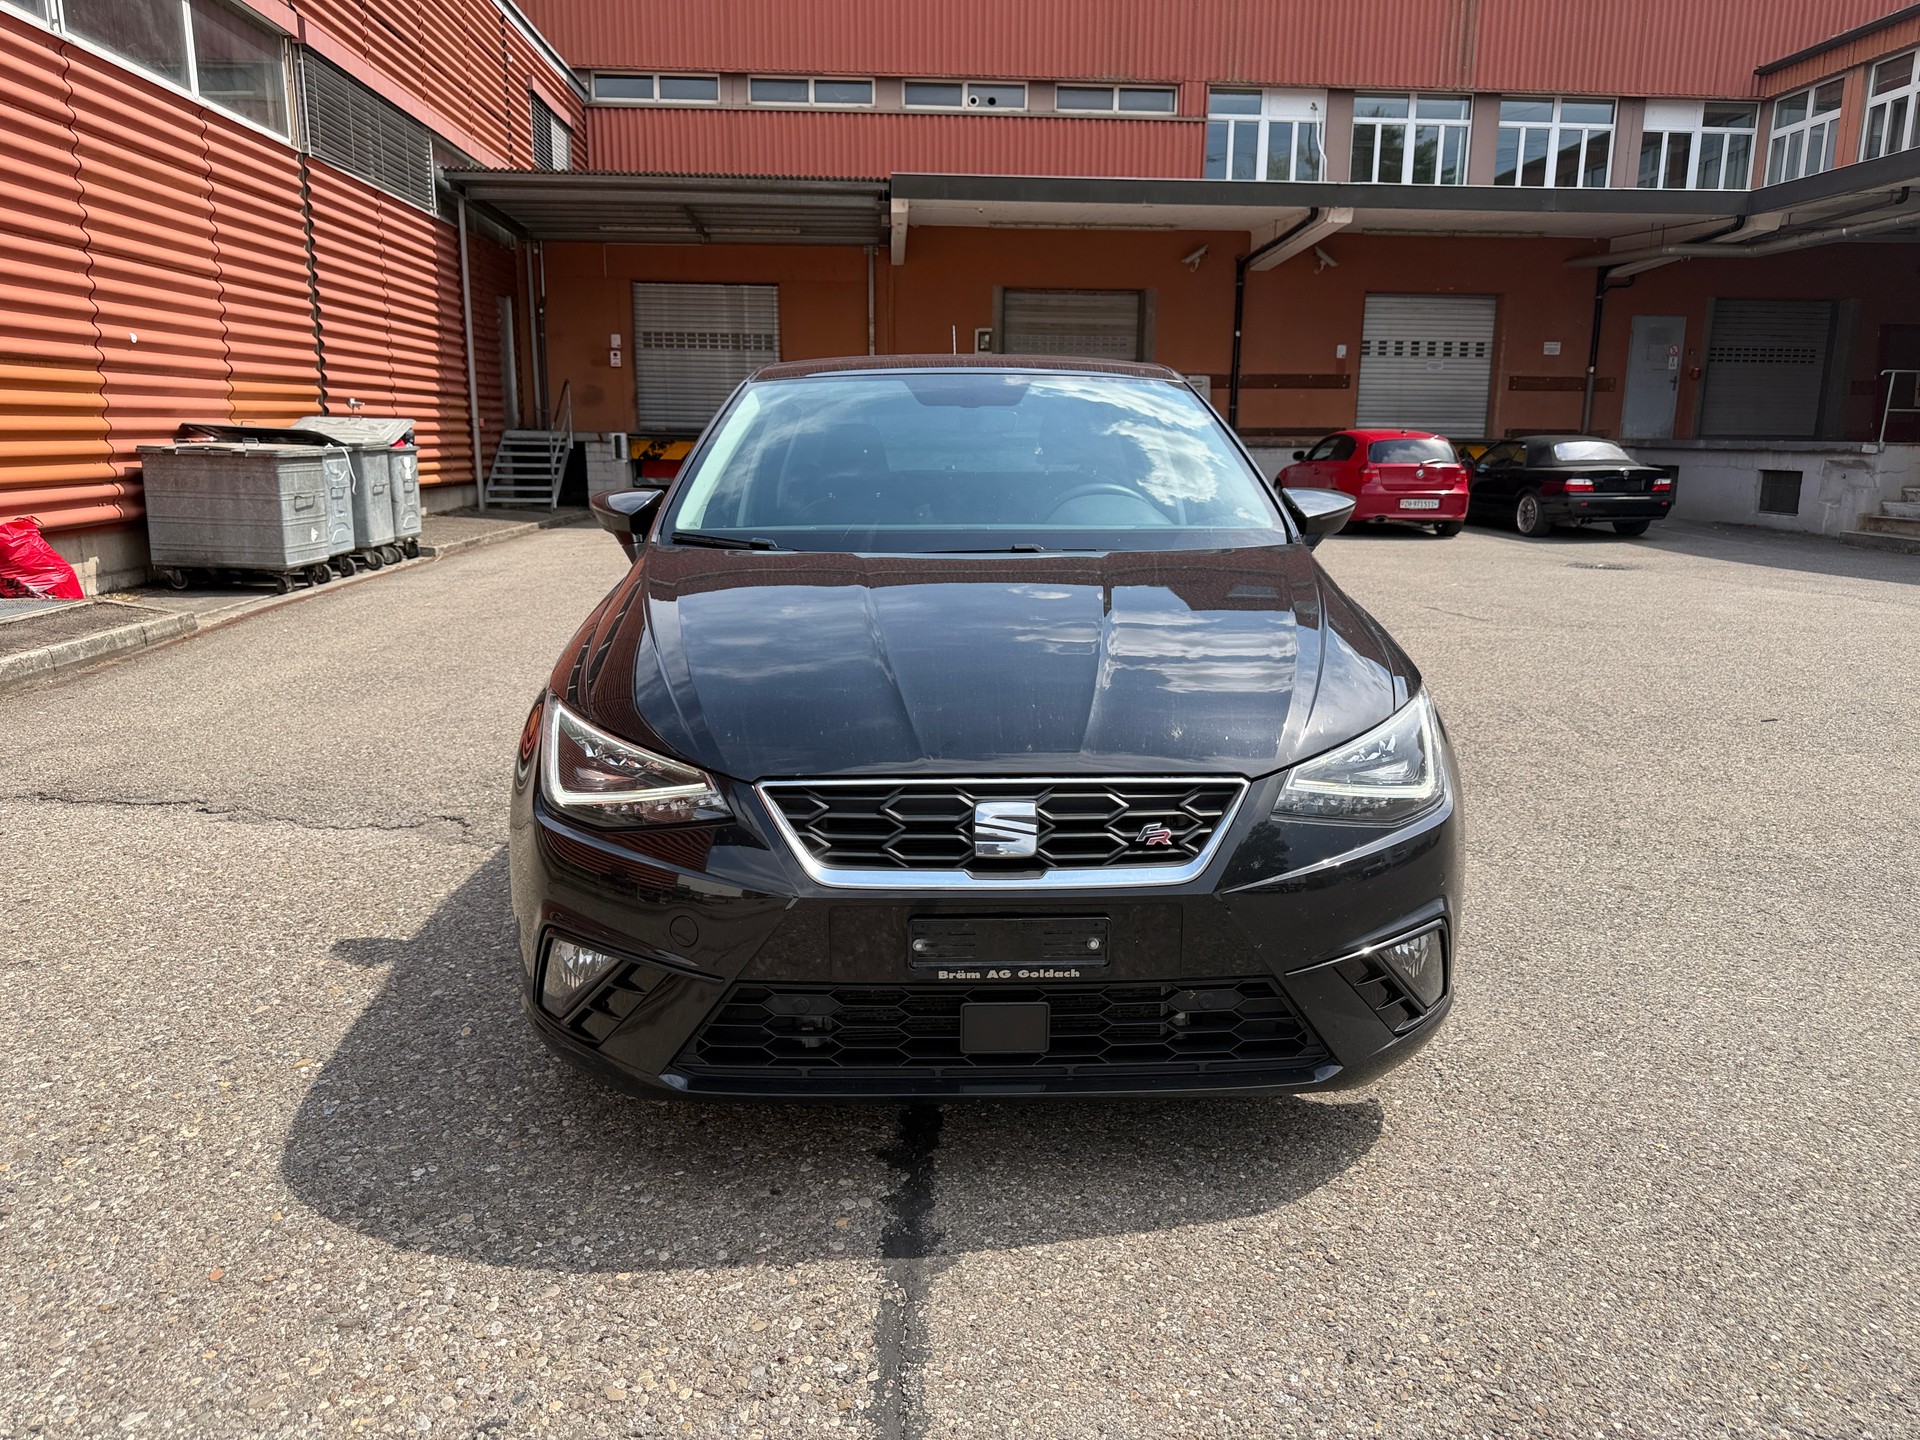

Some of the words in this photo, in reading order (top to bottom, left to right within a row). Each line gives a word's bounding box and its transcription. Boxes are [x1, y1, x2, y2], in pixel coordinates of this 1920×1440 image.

[1135, 822, 1172, 846] FR
[938, 970, 981, 979] Bräm
[986, 969, 1012, 979] AG
[1017, 968, 1080, 978] Goldach
